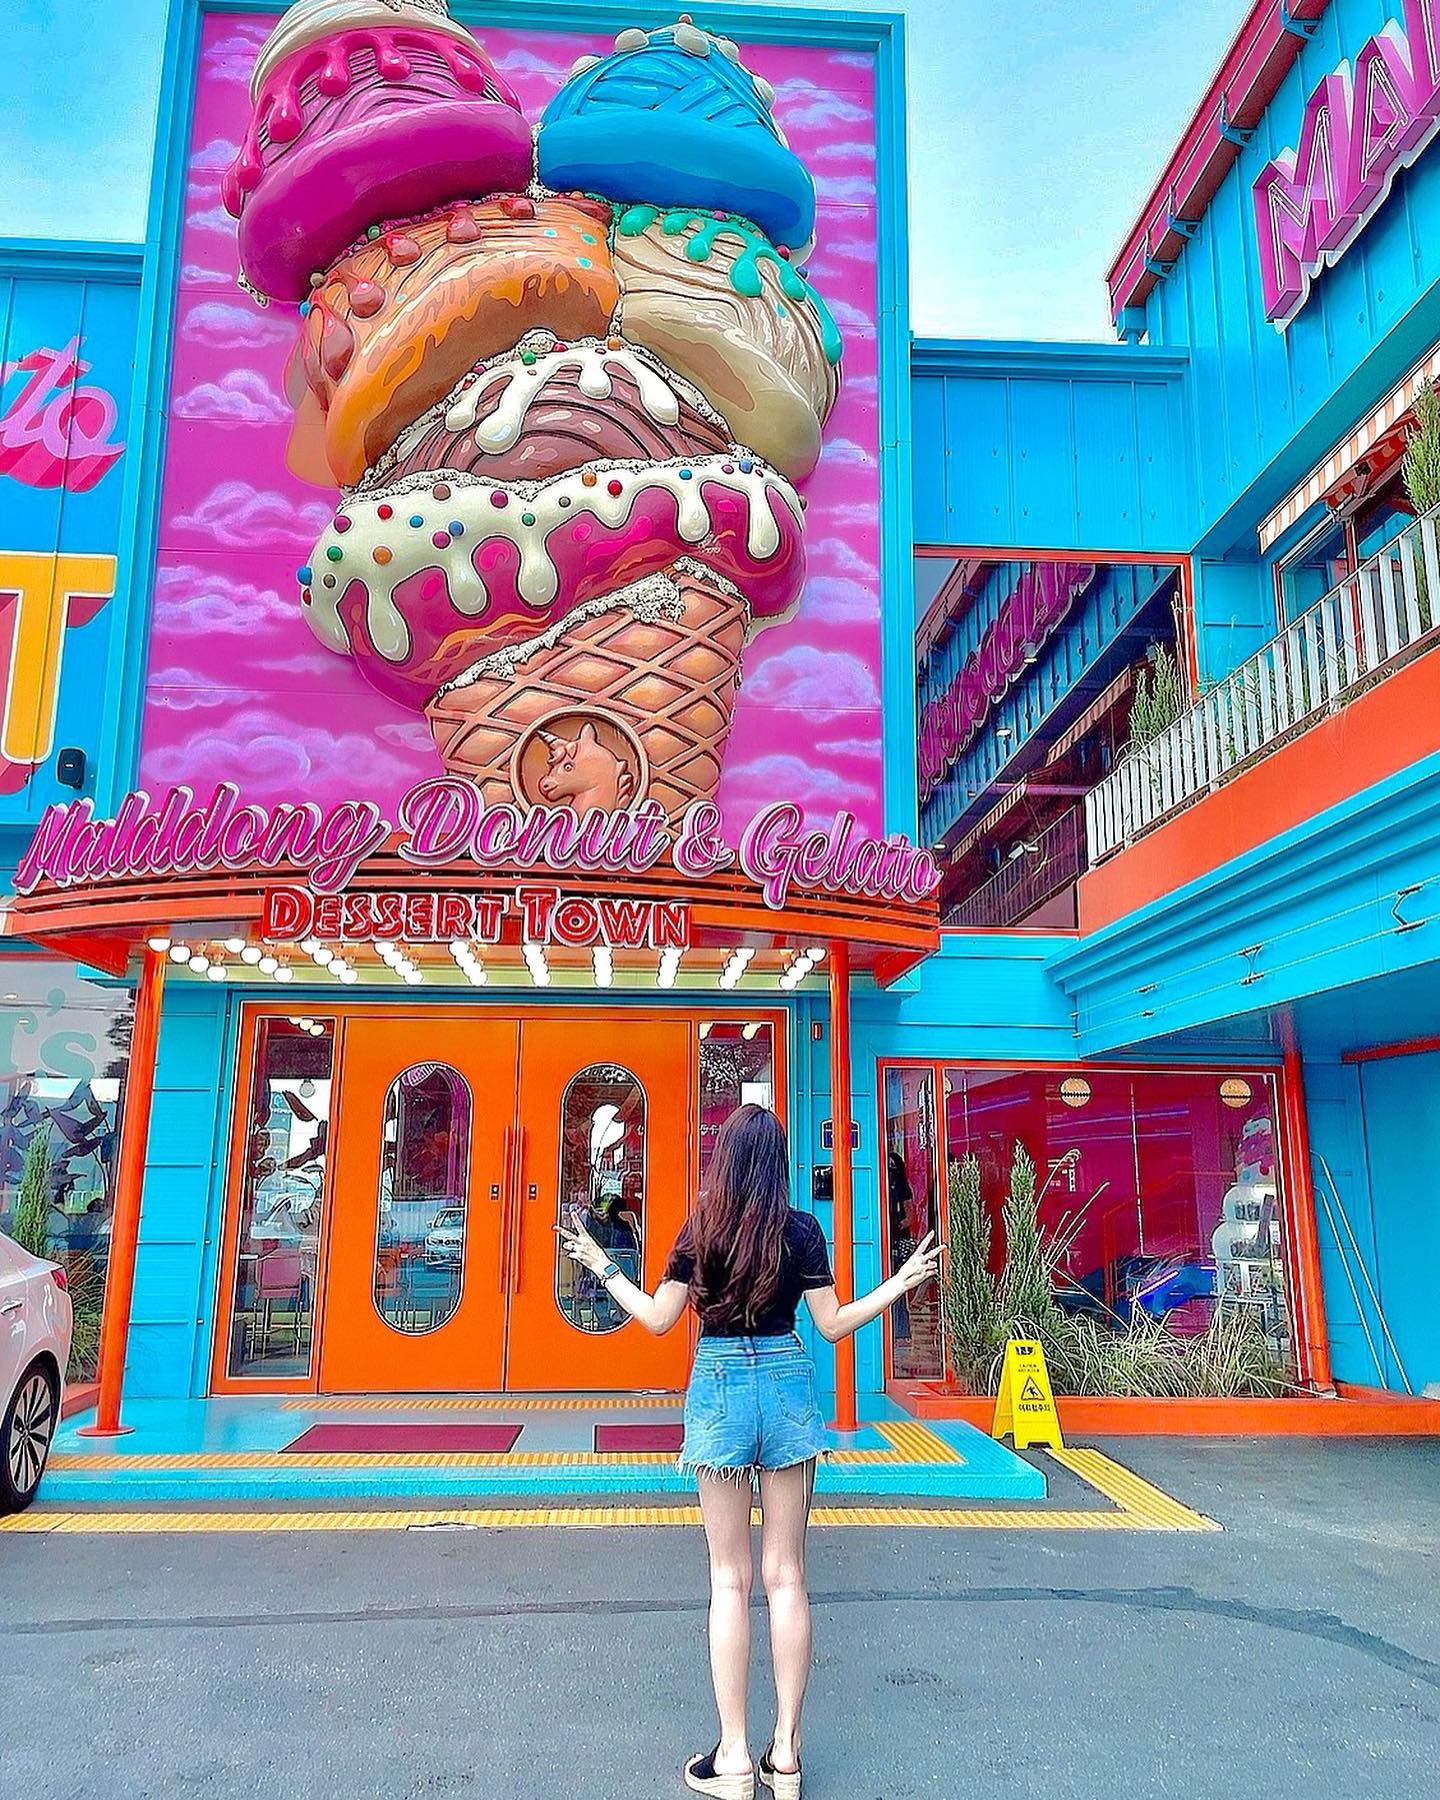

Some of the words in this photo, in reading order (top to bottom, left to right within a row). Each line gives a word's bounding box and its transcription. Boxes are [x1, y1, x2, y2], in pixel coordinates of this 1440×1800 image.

[12, 782, 391, 895] Malddong
[399, 776, 672, 874] Donut
[674, 801, 736, 877] &
[738, 801, 944, 910] Gelato
[261, 885, 510, 945] DESSERT
[515, 885, 691, 948] TOWN
